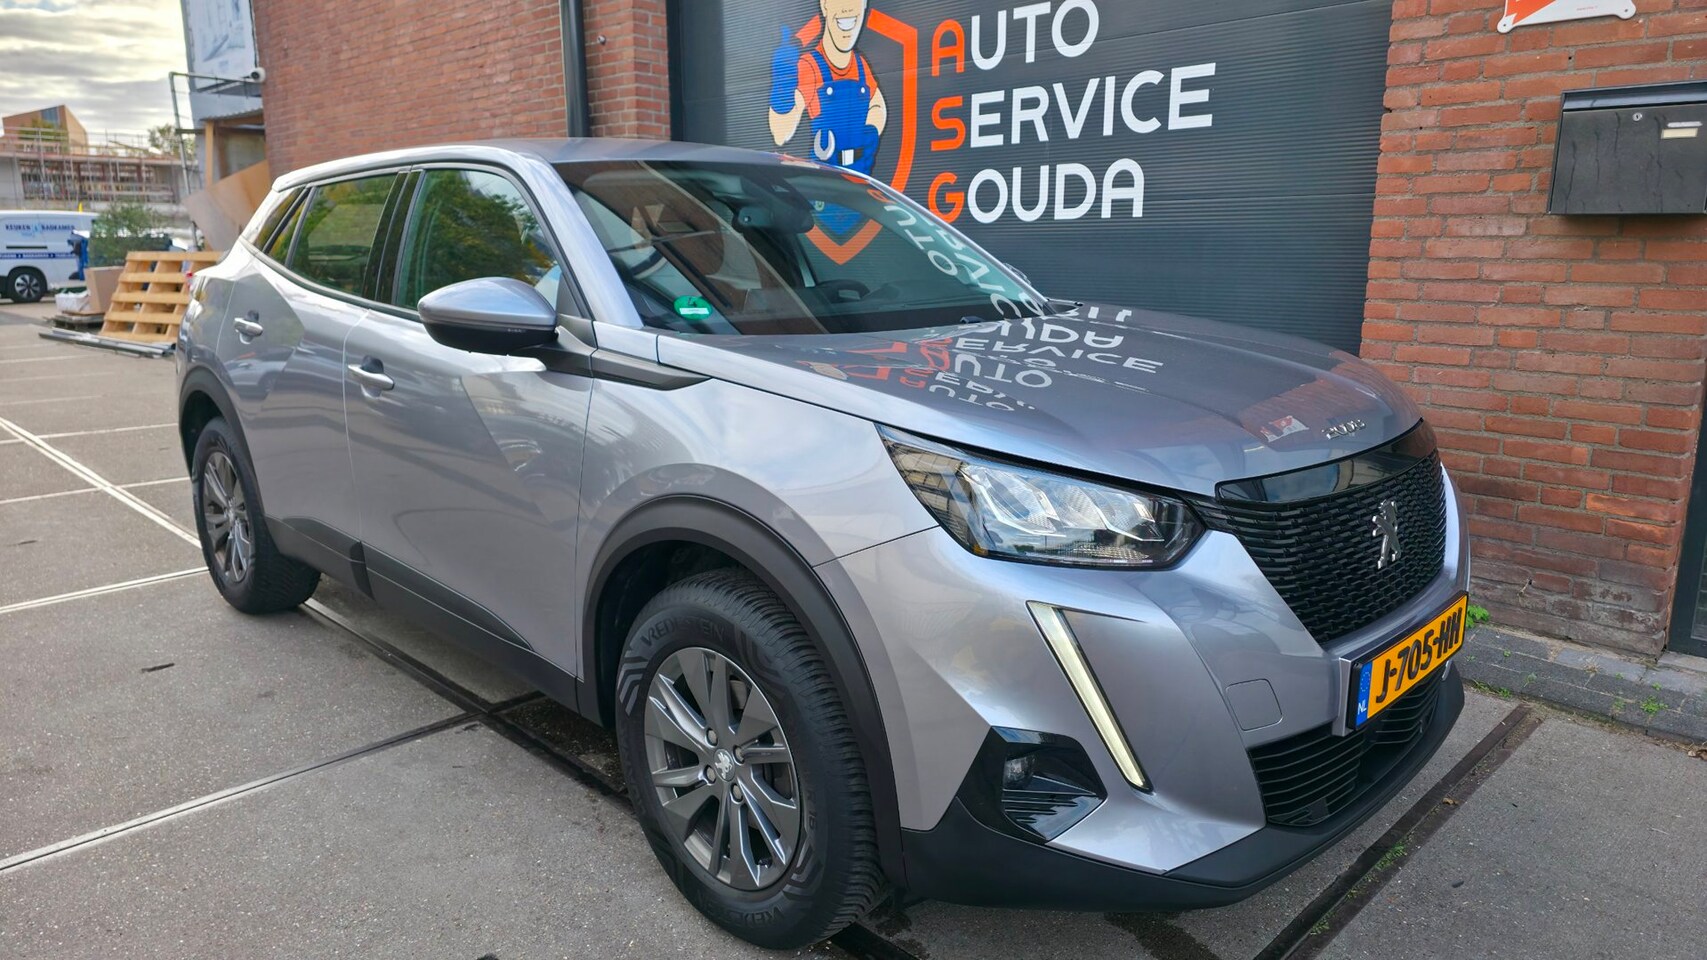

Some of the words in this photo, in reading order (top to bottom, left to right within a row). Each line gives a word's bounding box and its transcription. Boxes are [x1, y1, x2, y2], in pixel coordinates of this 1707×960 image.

[931, 0, 1100, 77] AUTO
[930, 62, 1217, 151] SERVICE
[927, 158, 1145, 224] GOUDA
[1358, 699, 1367, 715] NL
